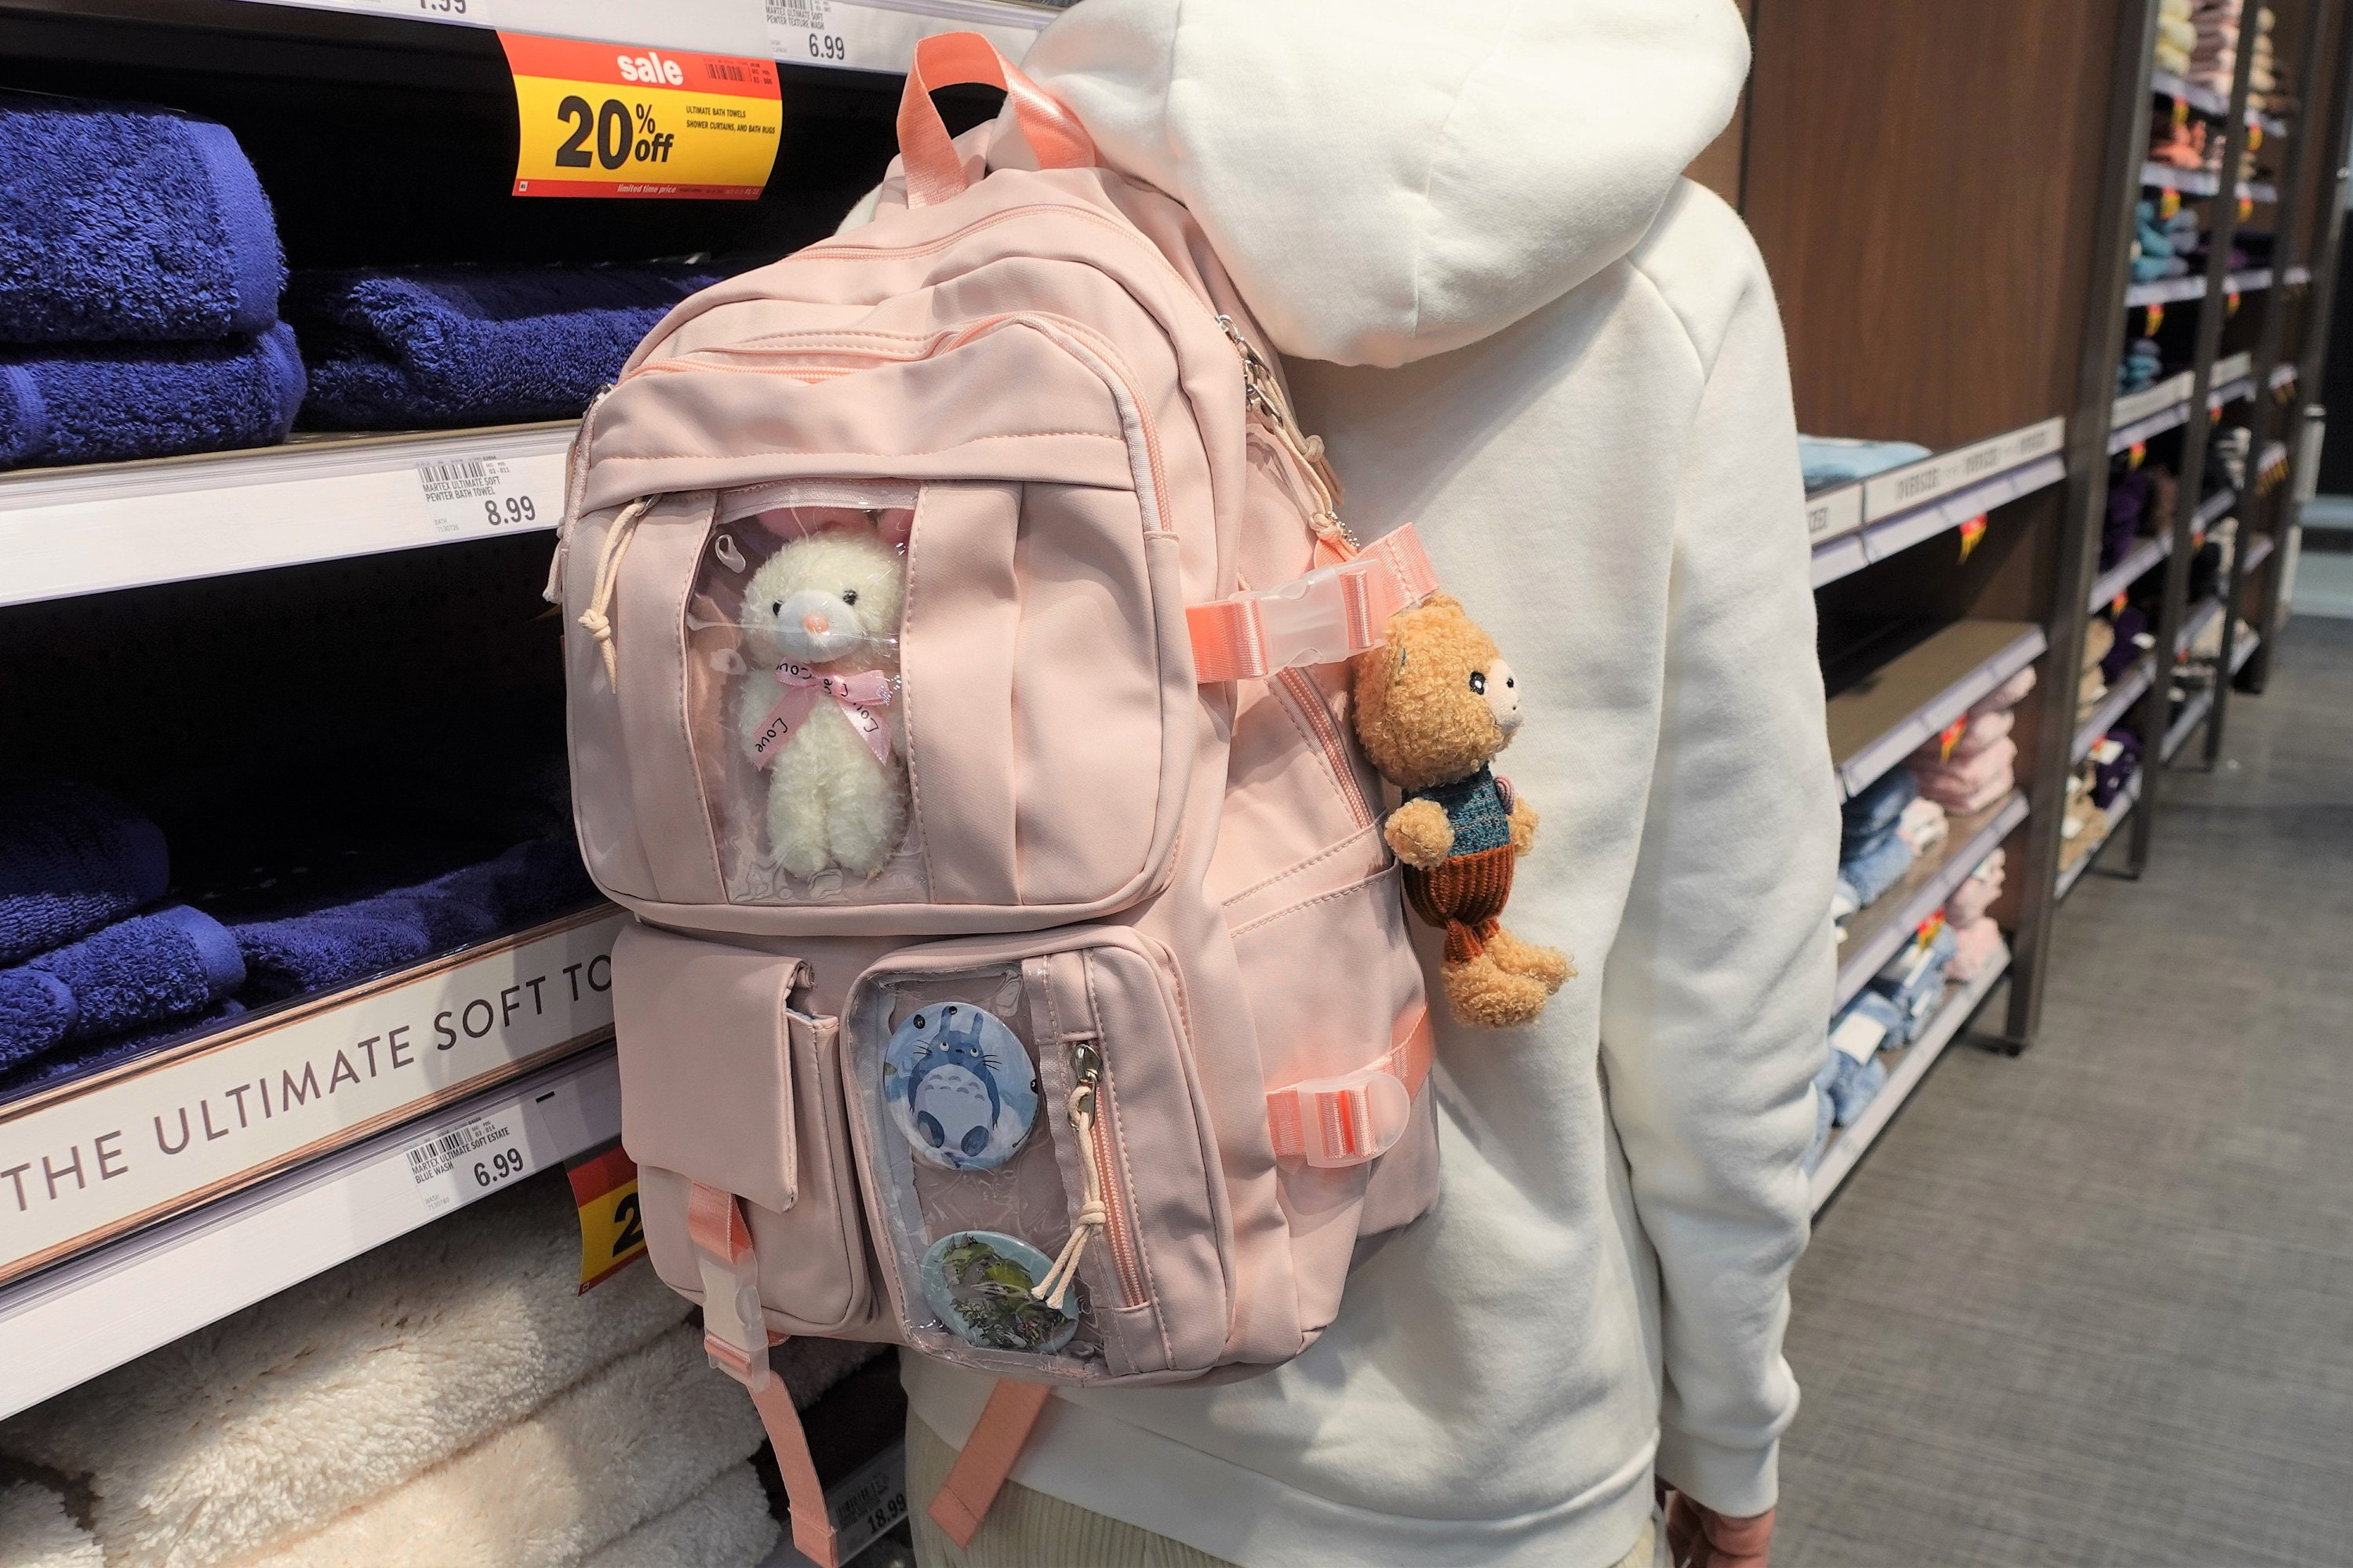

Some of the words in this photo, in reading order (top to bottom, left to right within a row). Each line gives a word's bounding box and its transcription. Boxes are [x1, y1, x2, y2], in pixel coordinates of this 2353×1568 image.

[809, 33, 845, 60] 6.99
[616, 52, 684, 85] sale
[686, 106, 711, 115] ULTIMATE
[712, 107, 726, 117] BATH
[726, 109, 746, 118] TOWELS
[686, 120, 708, 129] SHOWER
[710, 122, 736, 132] CURTAINS,
[762, 126, 776, 134] RUGS
[635, 133, 674, 162] off
[617, 184, 642, 193] limited
[658, 185, 677, 195] price
[422, 482, 449, 493] MARTEX
[452, 478, 483, 489] ULTIMATE
[485, 476, 500, 486] SOFT
[426, 490, 454, 502] PEWTER
[455, 489, 473, 500] BATH
[473, 486, 496, 497] TOWEL
[485, 496, 536, 526] 8.99
[0, 1130, 129, 1211] THE
[154, 1025, 414, 1155] ULTIMATE
[434, 976, 546, 1050] SOFT
[412, 1161, 439, 1175] MARTEX
[440, 1146, 471, 1163] ULTIMATE
[471, 1141, 487, 1150] SOFT
[488, 1126, 510, 1143] ESTATE
[415, 1173, 433, 1184] BLUE
[435, 1162, 454, 1175] WASH
[474, 1148, 524, 1187] 6.99
[867, 1493, 907, 1534] 18.99
